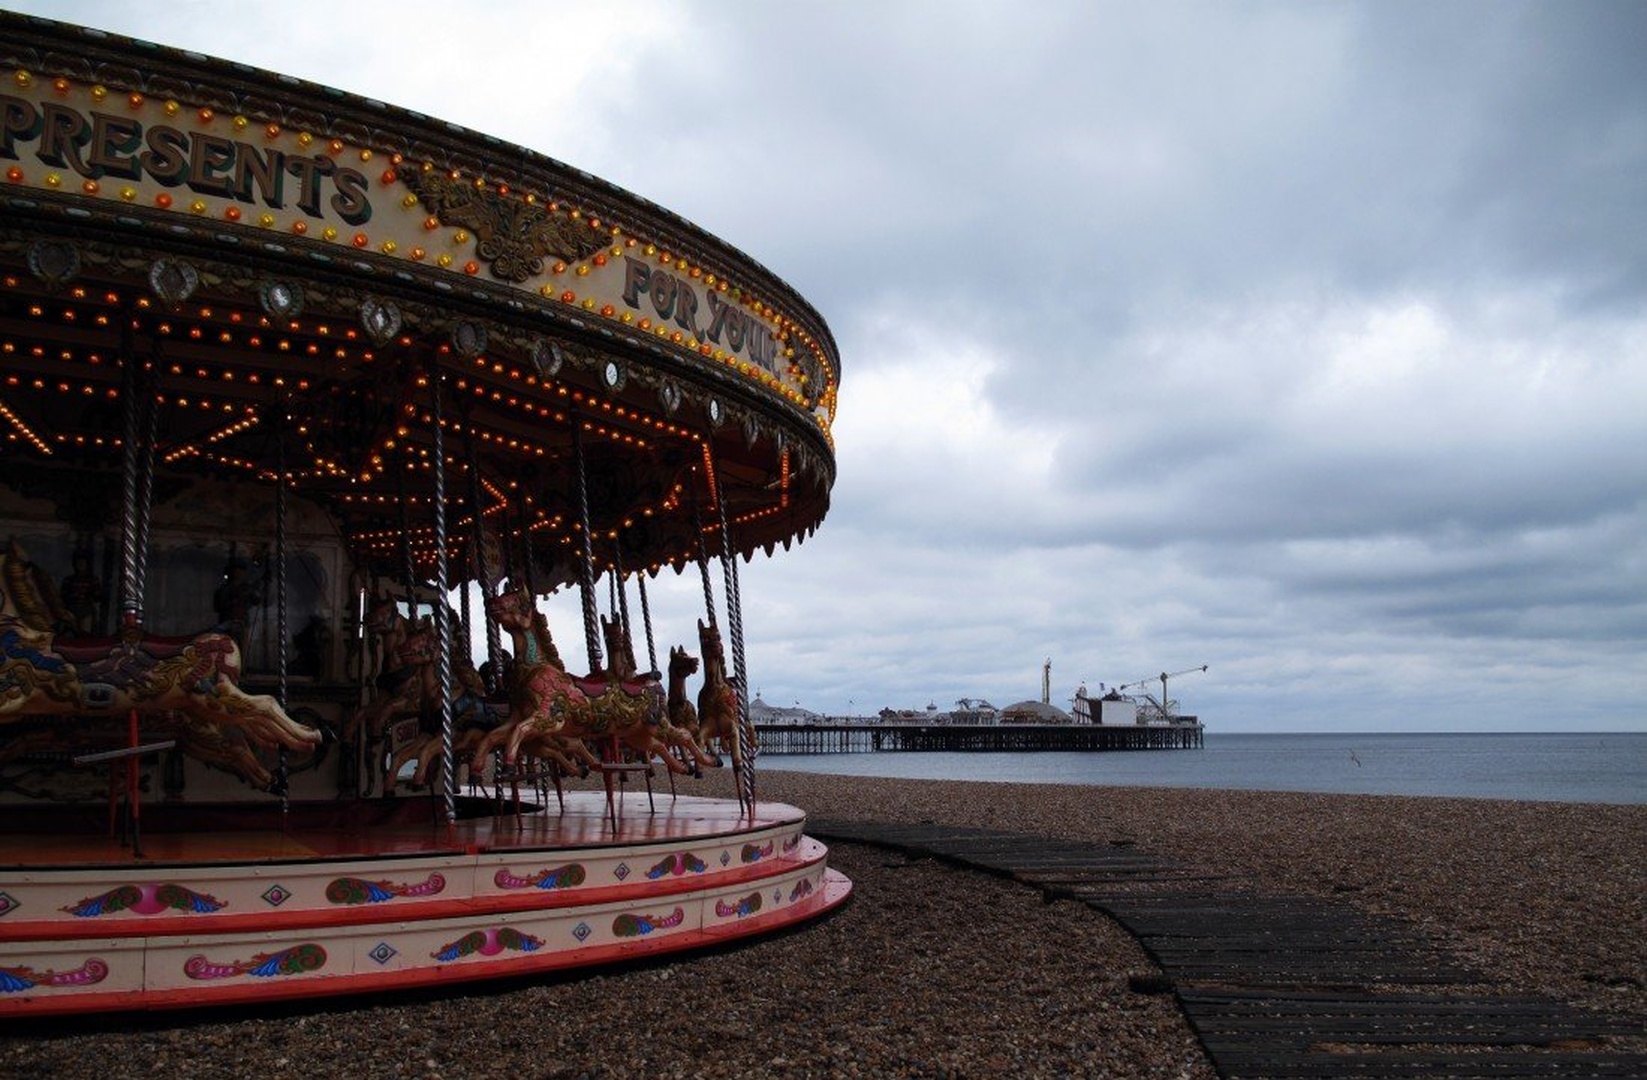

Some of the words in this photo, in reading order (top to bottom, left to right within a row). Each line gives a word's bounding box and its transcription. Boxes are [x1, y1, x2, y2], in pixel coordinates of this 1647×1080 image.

[0, 94, 373, 226] PRESENTS
[622, 255, 705, 344] FOR
[706, 289, 780, 382] YOUR
